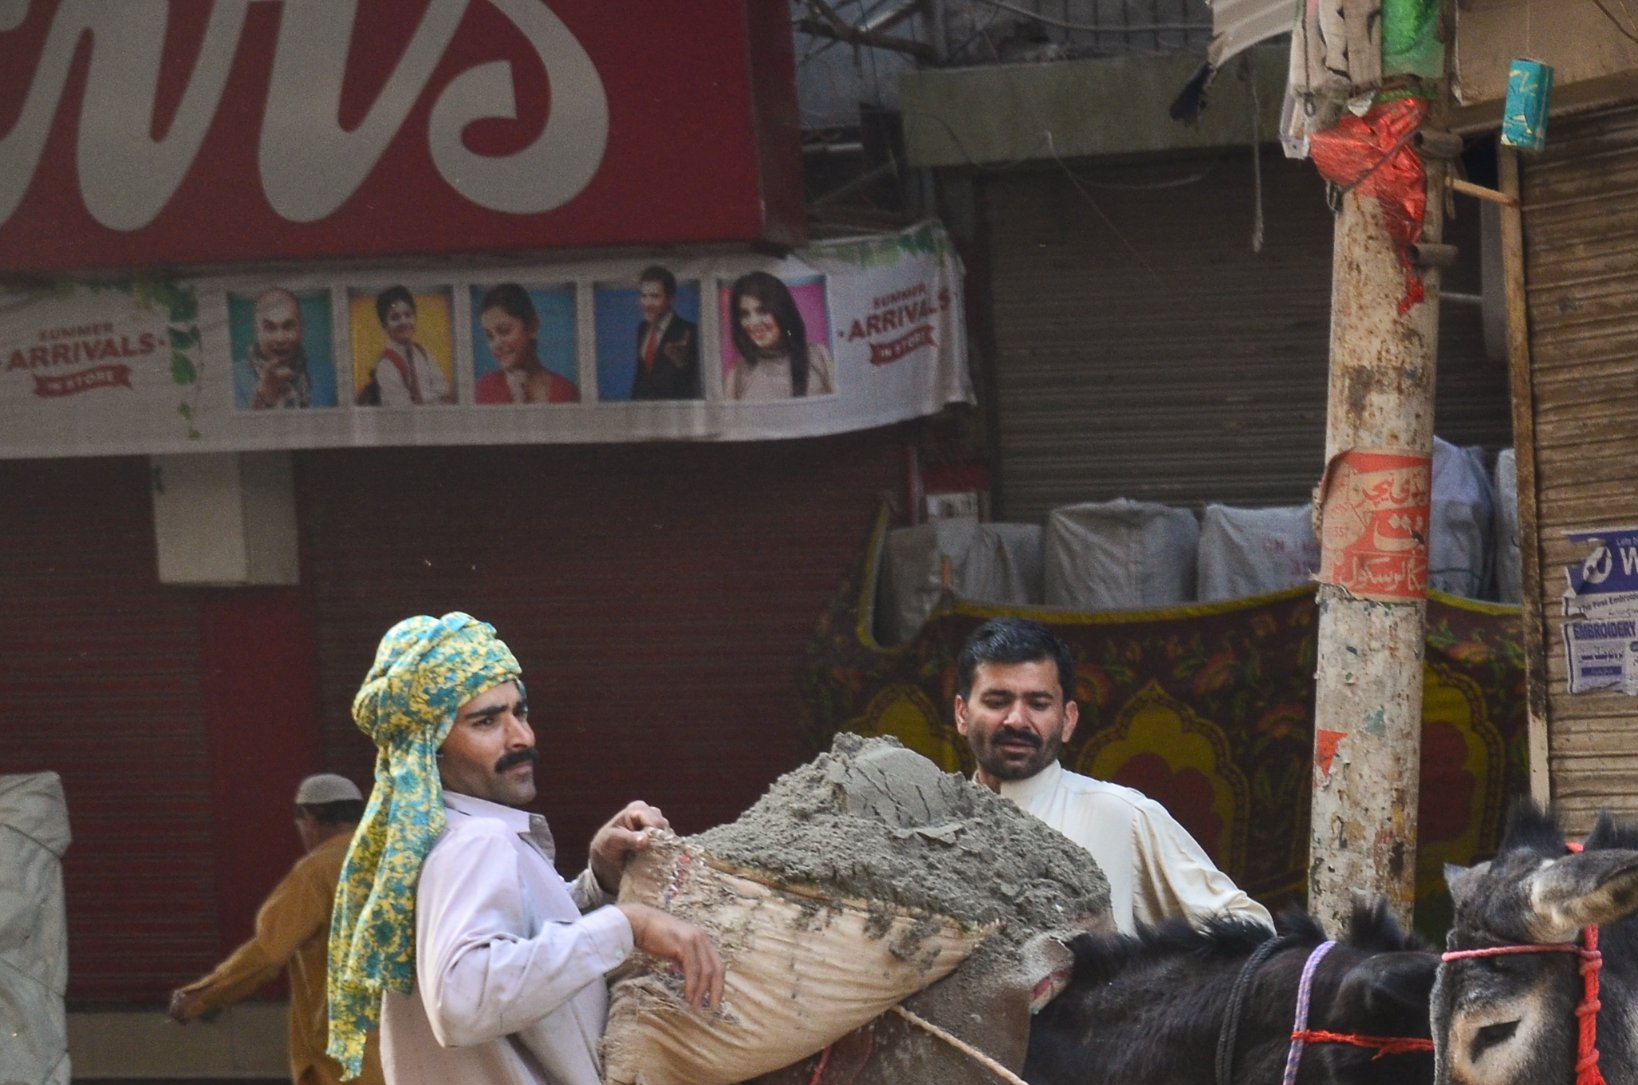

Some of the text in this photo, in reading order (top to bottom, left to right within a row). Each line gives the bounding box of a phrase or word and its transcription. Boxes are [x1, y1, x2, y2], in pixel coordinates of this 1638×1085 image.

[38, 322, 114, 341] SUMMER
[7, 332, 155, 371] ARRIVALS
[1573, 621, 1636, 640] EMBROIDERY
